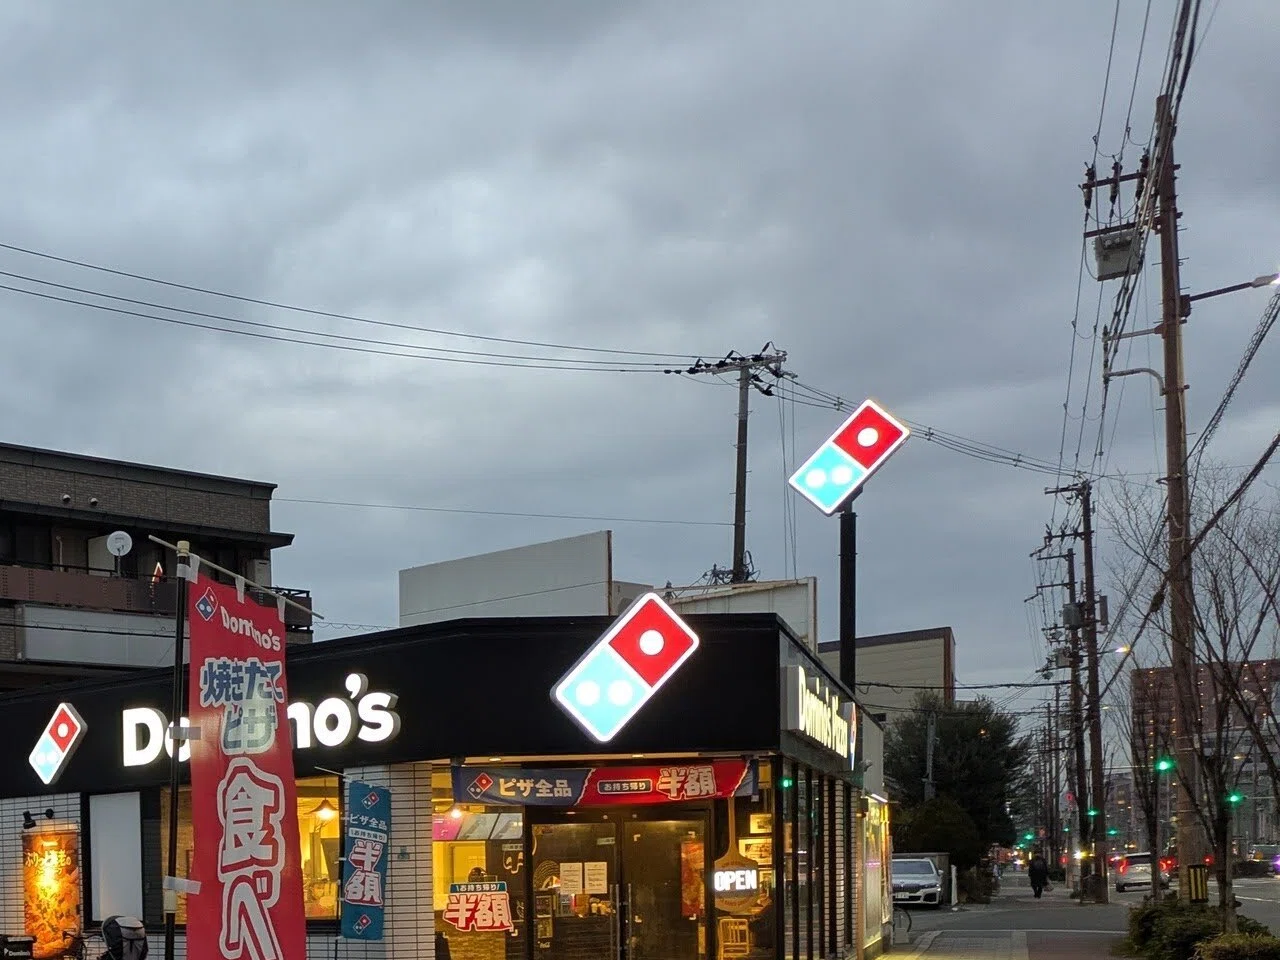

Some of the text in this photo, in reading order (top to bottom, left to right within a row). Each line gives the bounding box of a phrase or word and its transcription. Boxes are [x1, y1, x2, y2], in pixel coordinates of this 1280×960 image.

[220, 605, 281, 652] Domino's
[202, 659, 284, 703] 焼きたて
[123, 673, 396, 767] Dono's
[223, 706, 276, 750] ピザ
[498, 766, 716, 800] ピザ全品 お持ち帰り 半額
[349, 813, 388, 831] ピザ全品
[347, 841, 381, 904] 半額
[458, 883, 496, 892] お持ち帰り
[714, 869, 758, 892] OPEN
[445, 893, 512, 930] 半額
